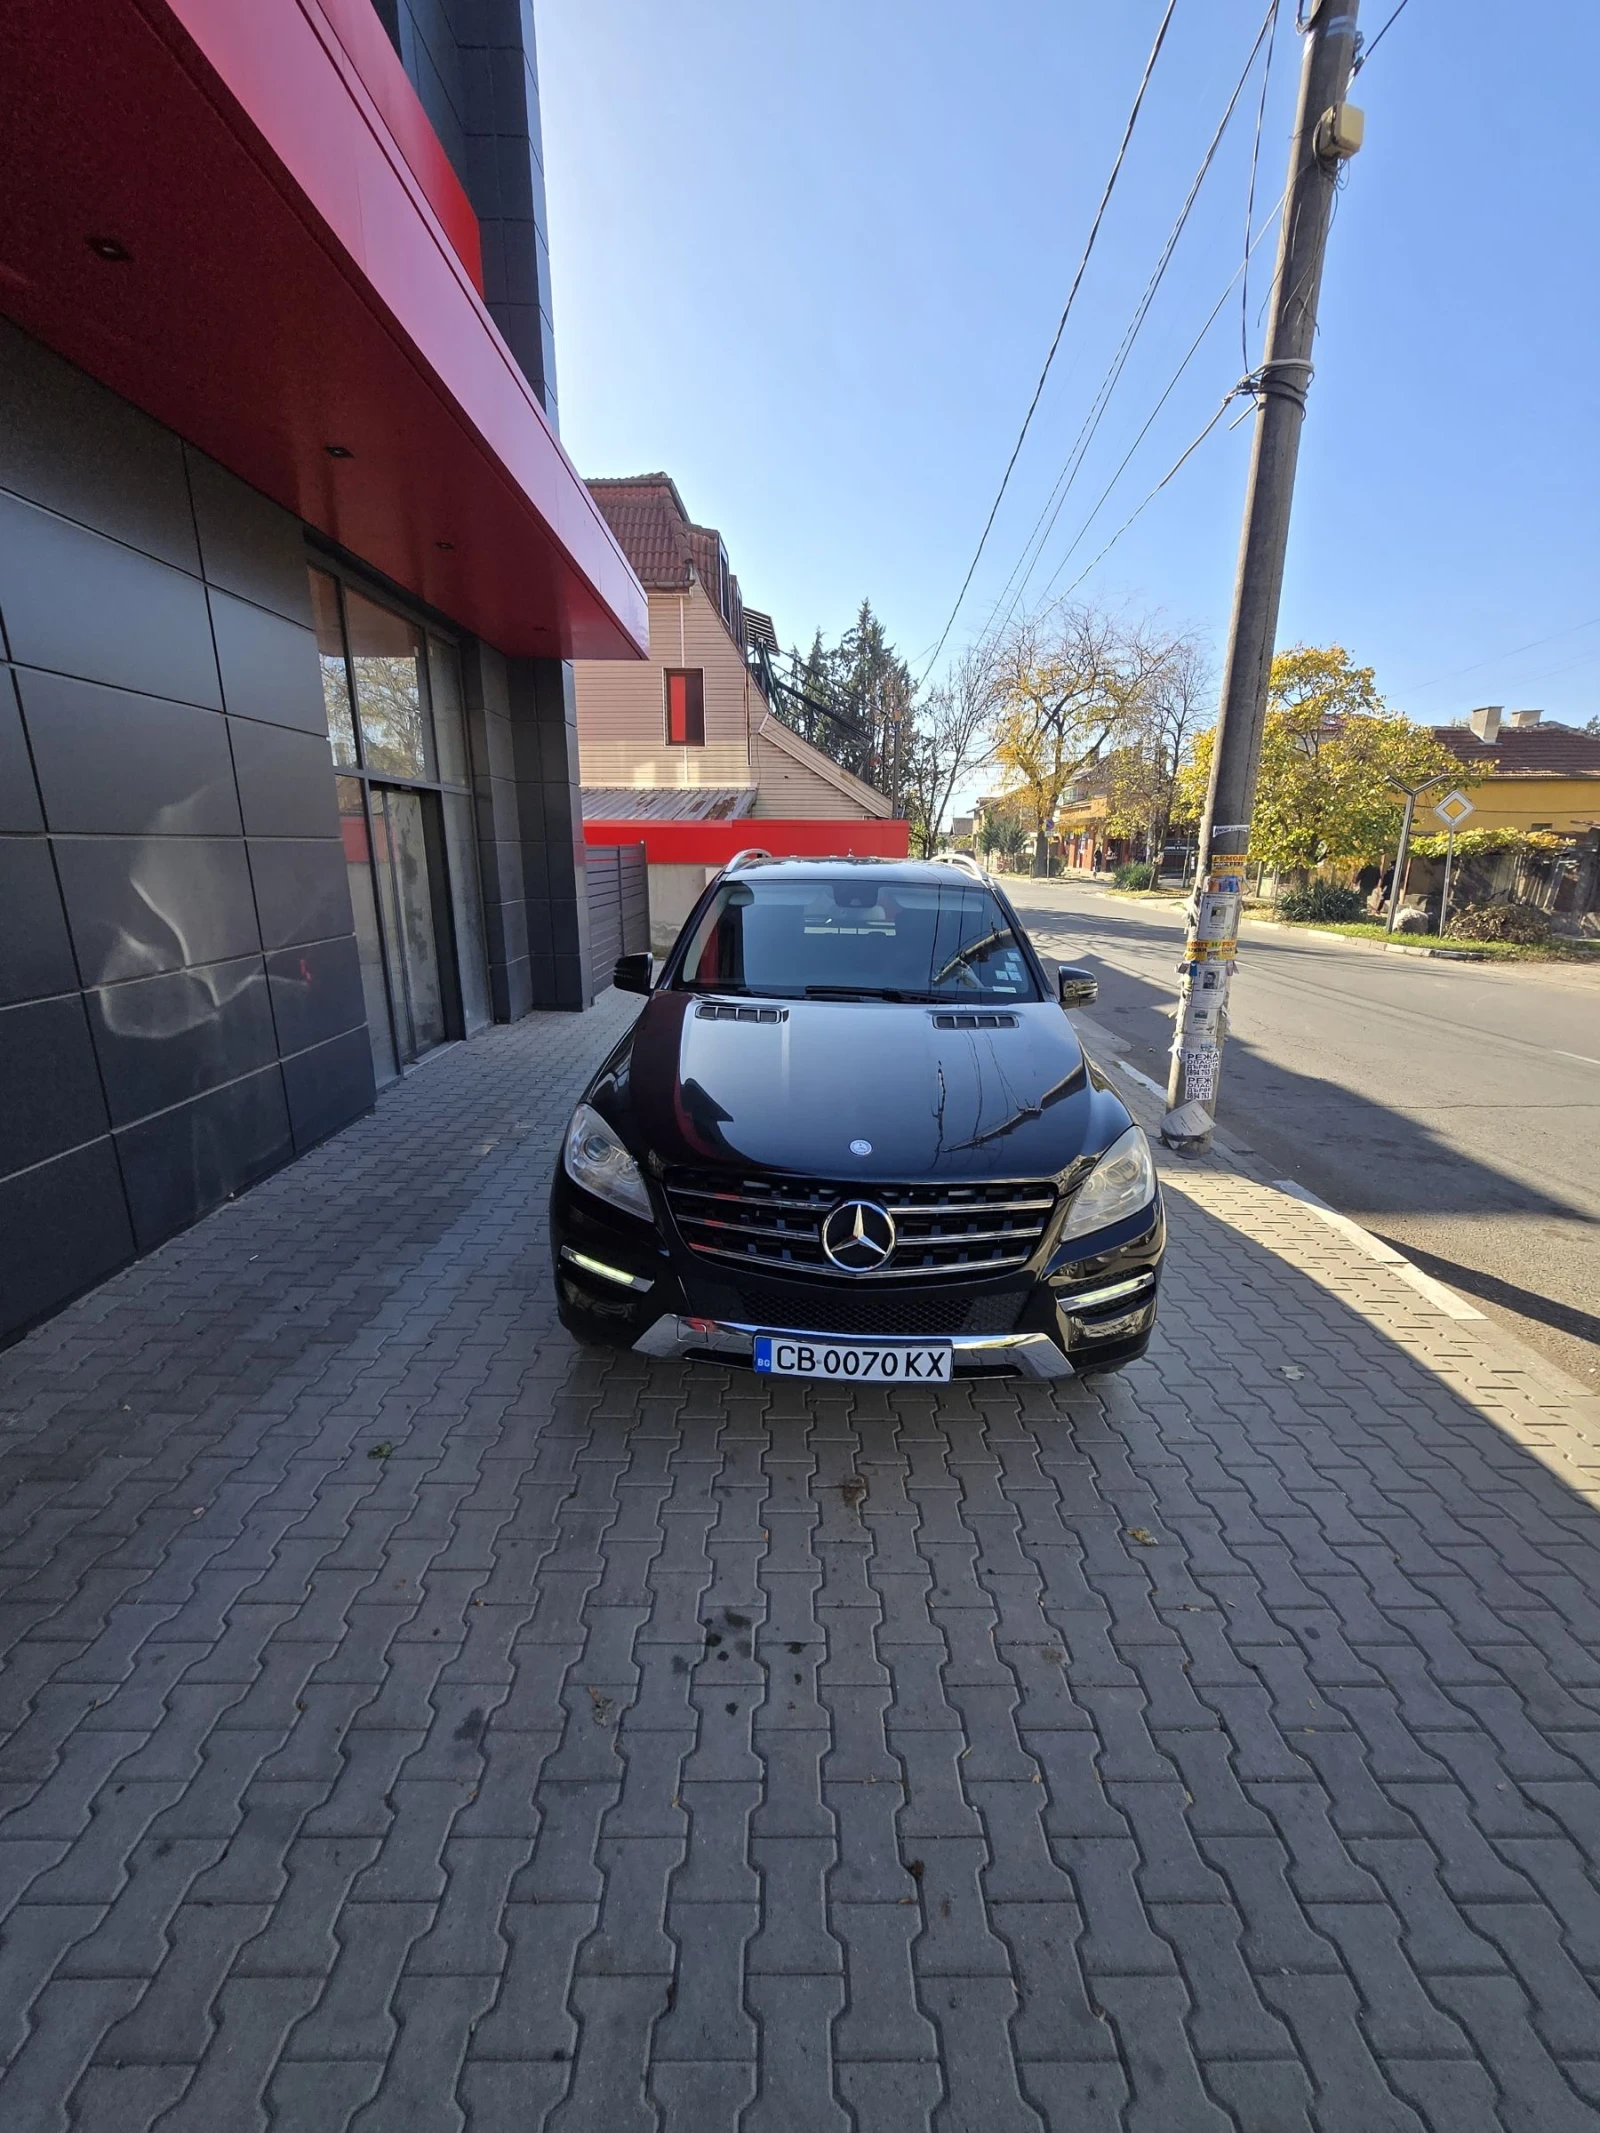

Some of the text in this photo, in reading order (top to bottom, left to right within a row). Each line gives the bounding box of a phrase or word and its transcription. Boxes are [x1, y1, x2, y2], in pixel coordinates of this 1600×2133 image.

[1187, 1052, 1219, 1060] РЕЖА
[757, 1345, 946, 1378] BG CB 0070 KX
